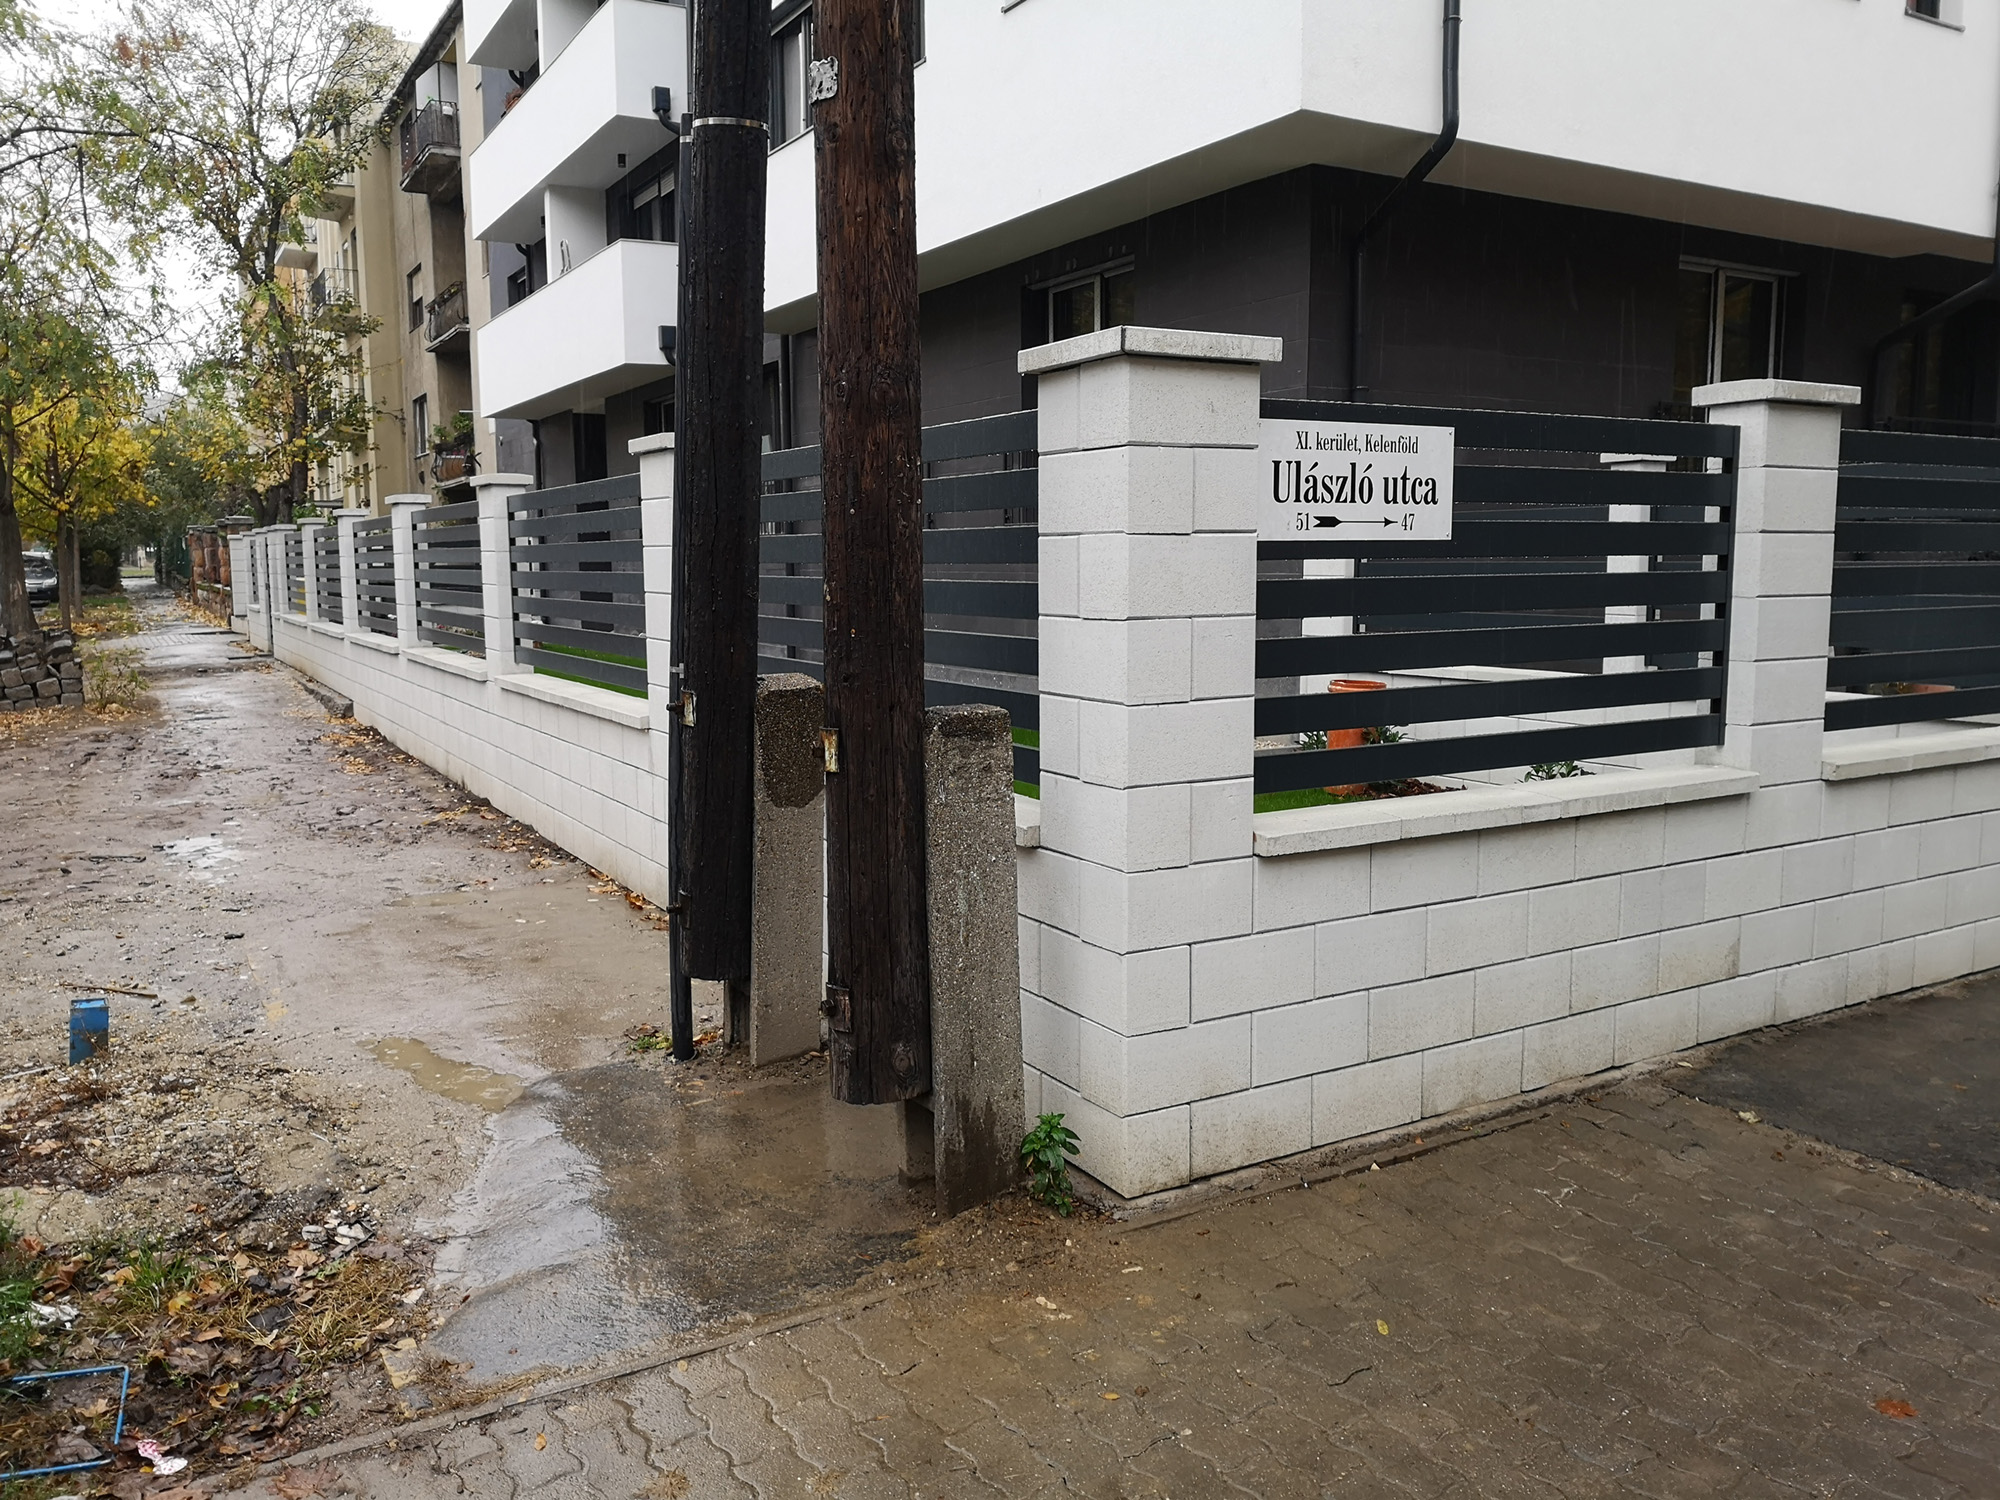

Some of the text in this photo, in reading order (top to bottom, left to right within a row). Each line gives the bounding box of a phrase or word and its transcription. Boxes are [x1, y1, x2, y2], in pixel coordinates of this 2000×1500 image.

[1295, 431, 1419, 455] XI. kerület, Kelenföld
[1272, 460, 1438, 505] Ulászló utca
[1296, 512, 1415, 531] 51 47
